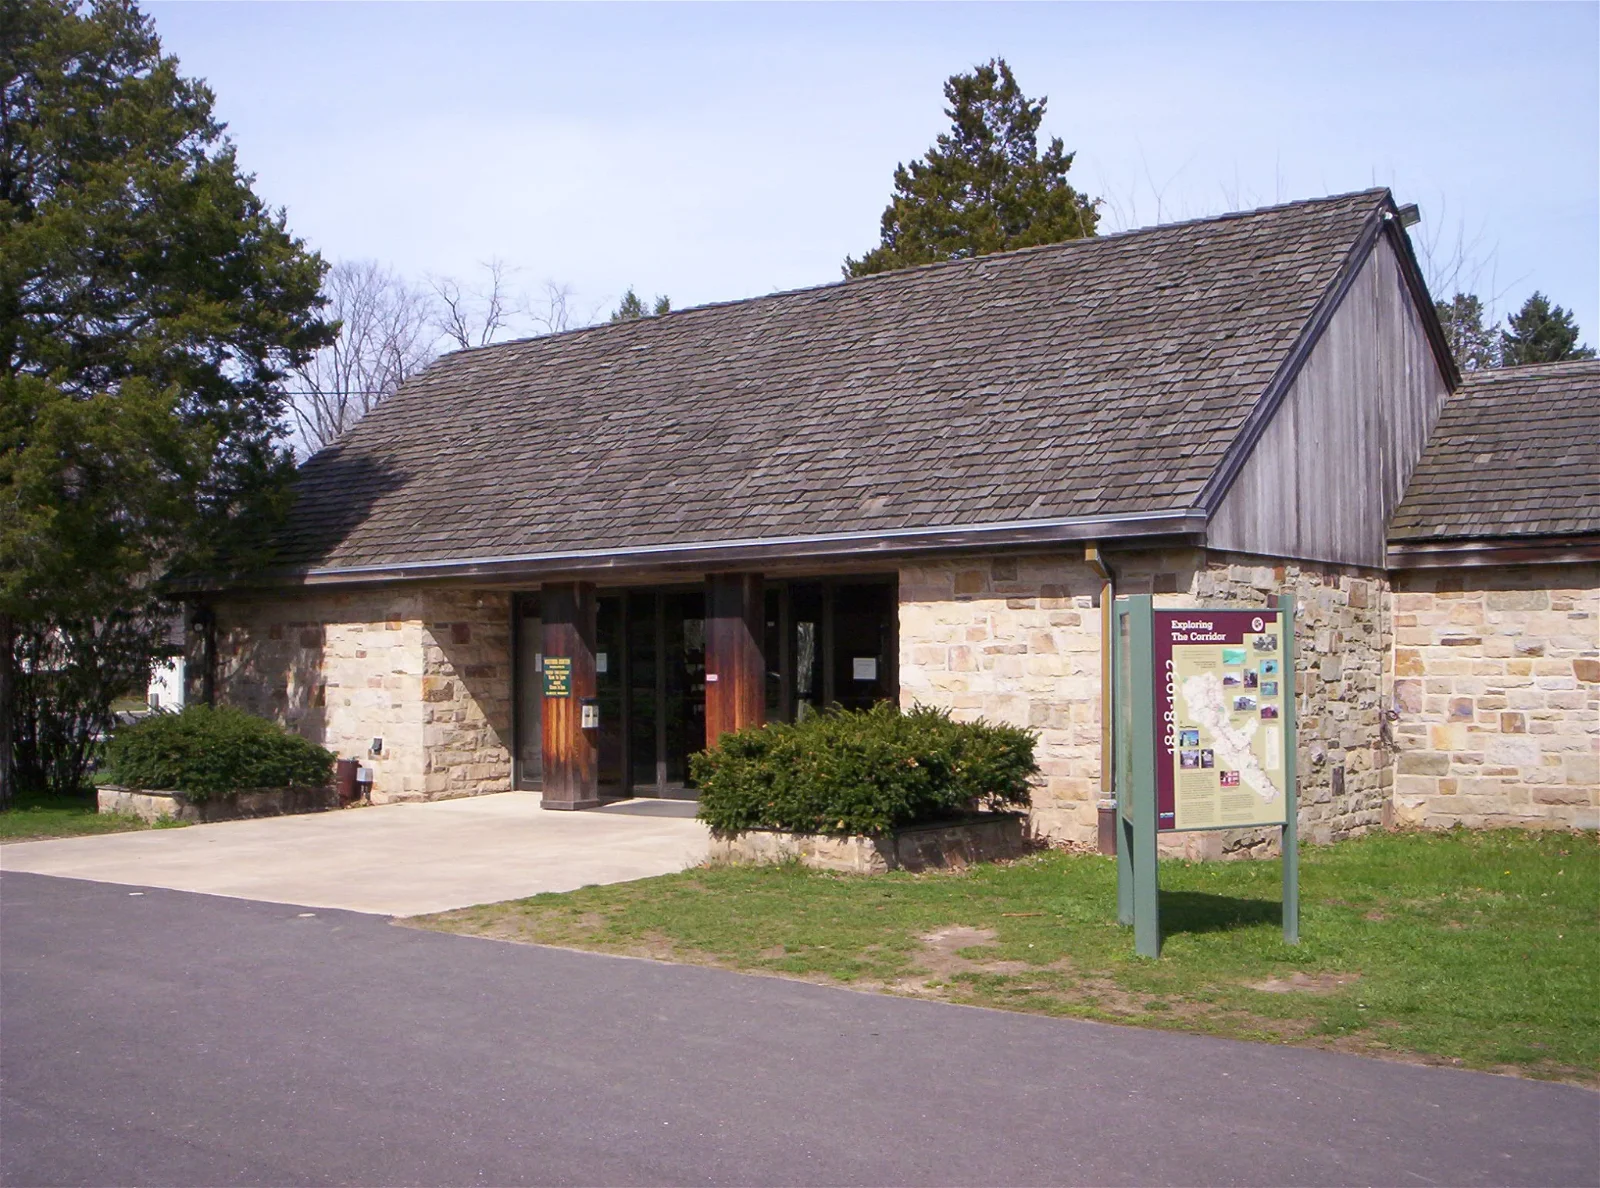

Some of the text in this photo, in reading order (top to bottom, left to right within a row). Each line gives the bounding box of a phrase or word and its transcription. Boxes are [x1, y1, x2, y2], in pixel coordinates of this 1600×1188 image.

[1171, 620, 1214, 631] Exploring
[1171, 632, 1227, 641] The Corridor
[1164, 659, 1181, 755] 1828-1932
